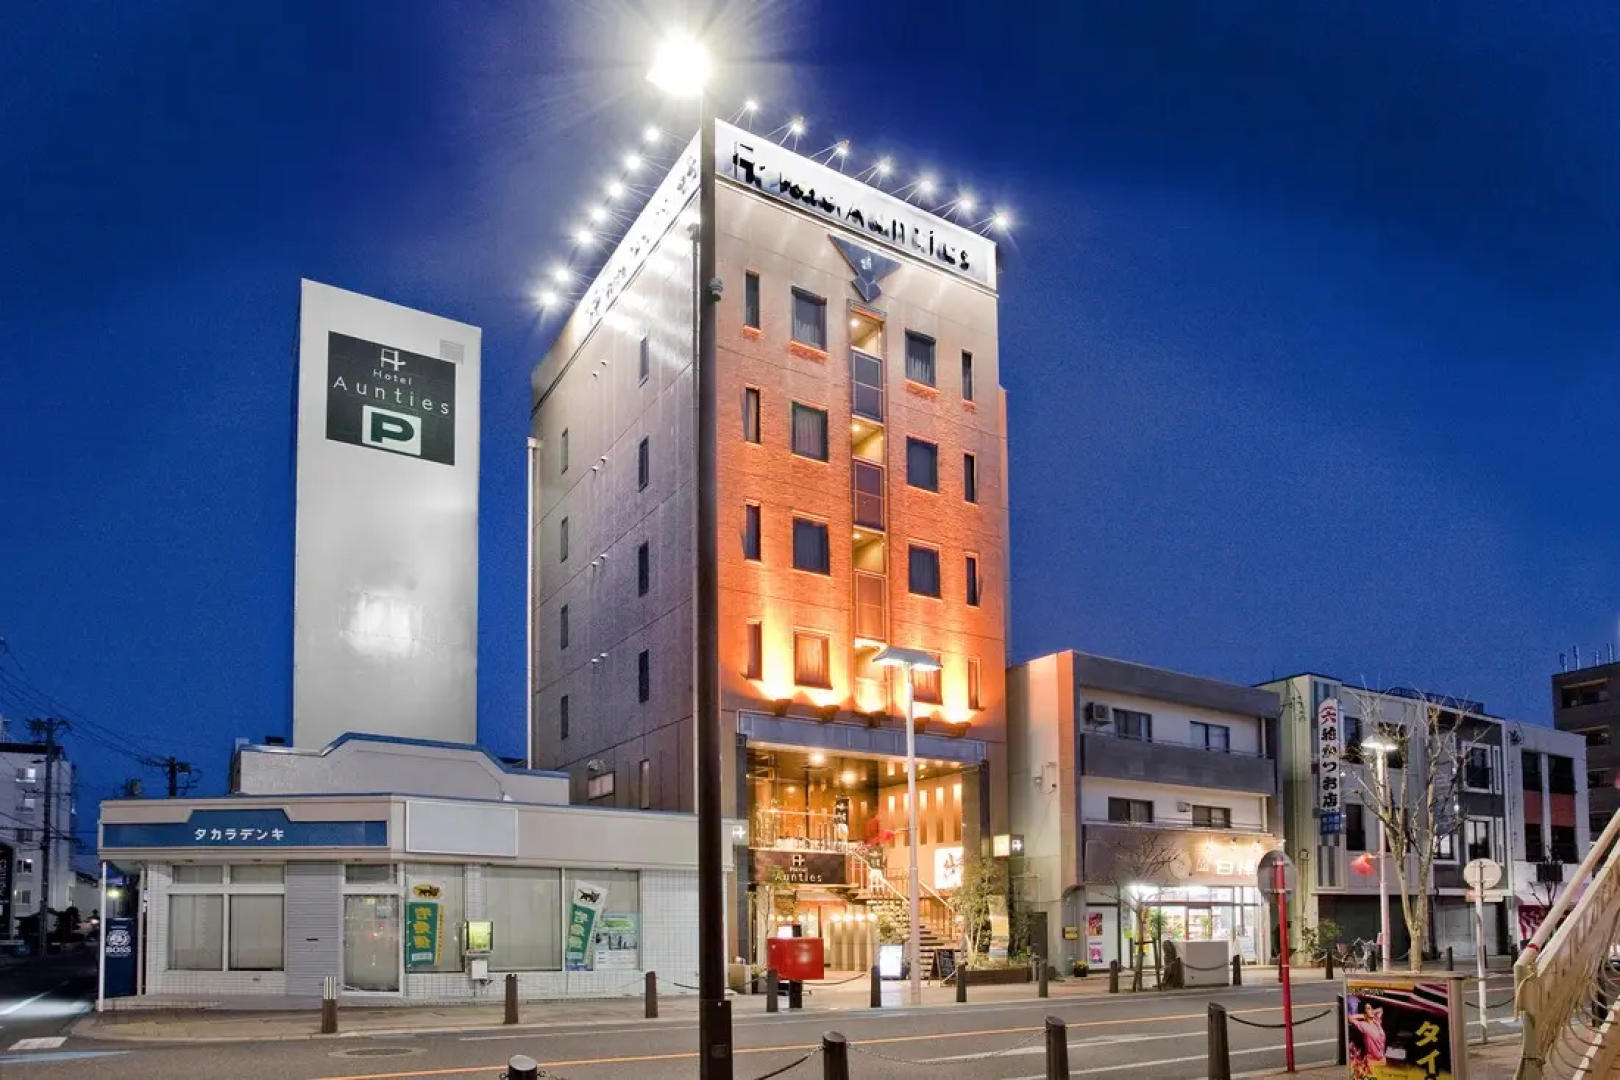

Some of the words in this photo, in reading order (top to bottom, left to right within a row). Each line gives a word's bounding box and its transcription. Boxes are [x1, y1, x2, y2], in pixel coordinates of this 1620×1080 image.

[373, 368, 412, 386] Hotel
[333, 376, 450, 415] Aunties
[370, 411, 415, 444] P
[194, 827, 285, 841] タカラデンキ
[774, 872, 822, 883] Aunties
[105, 945, 132, 953] BOSS
[1415, 1020, 1440, 1080] タイ
